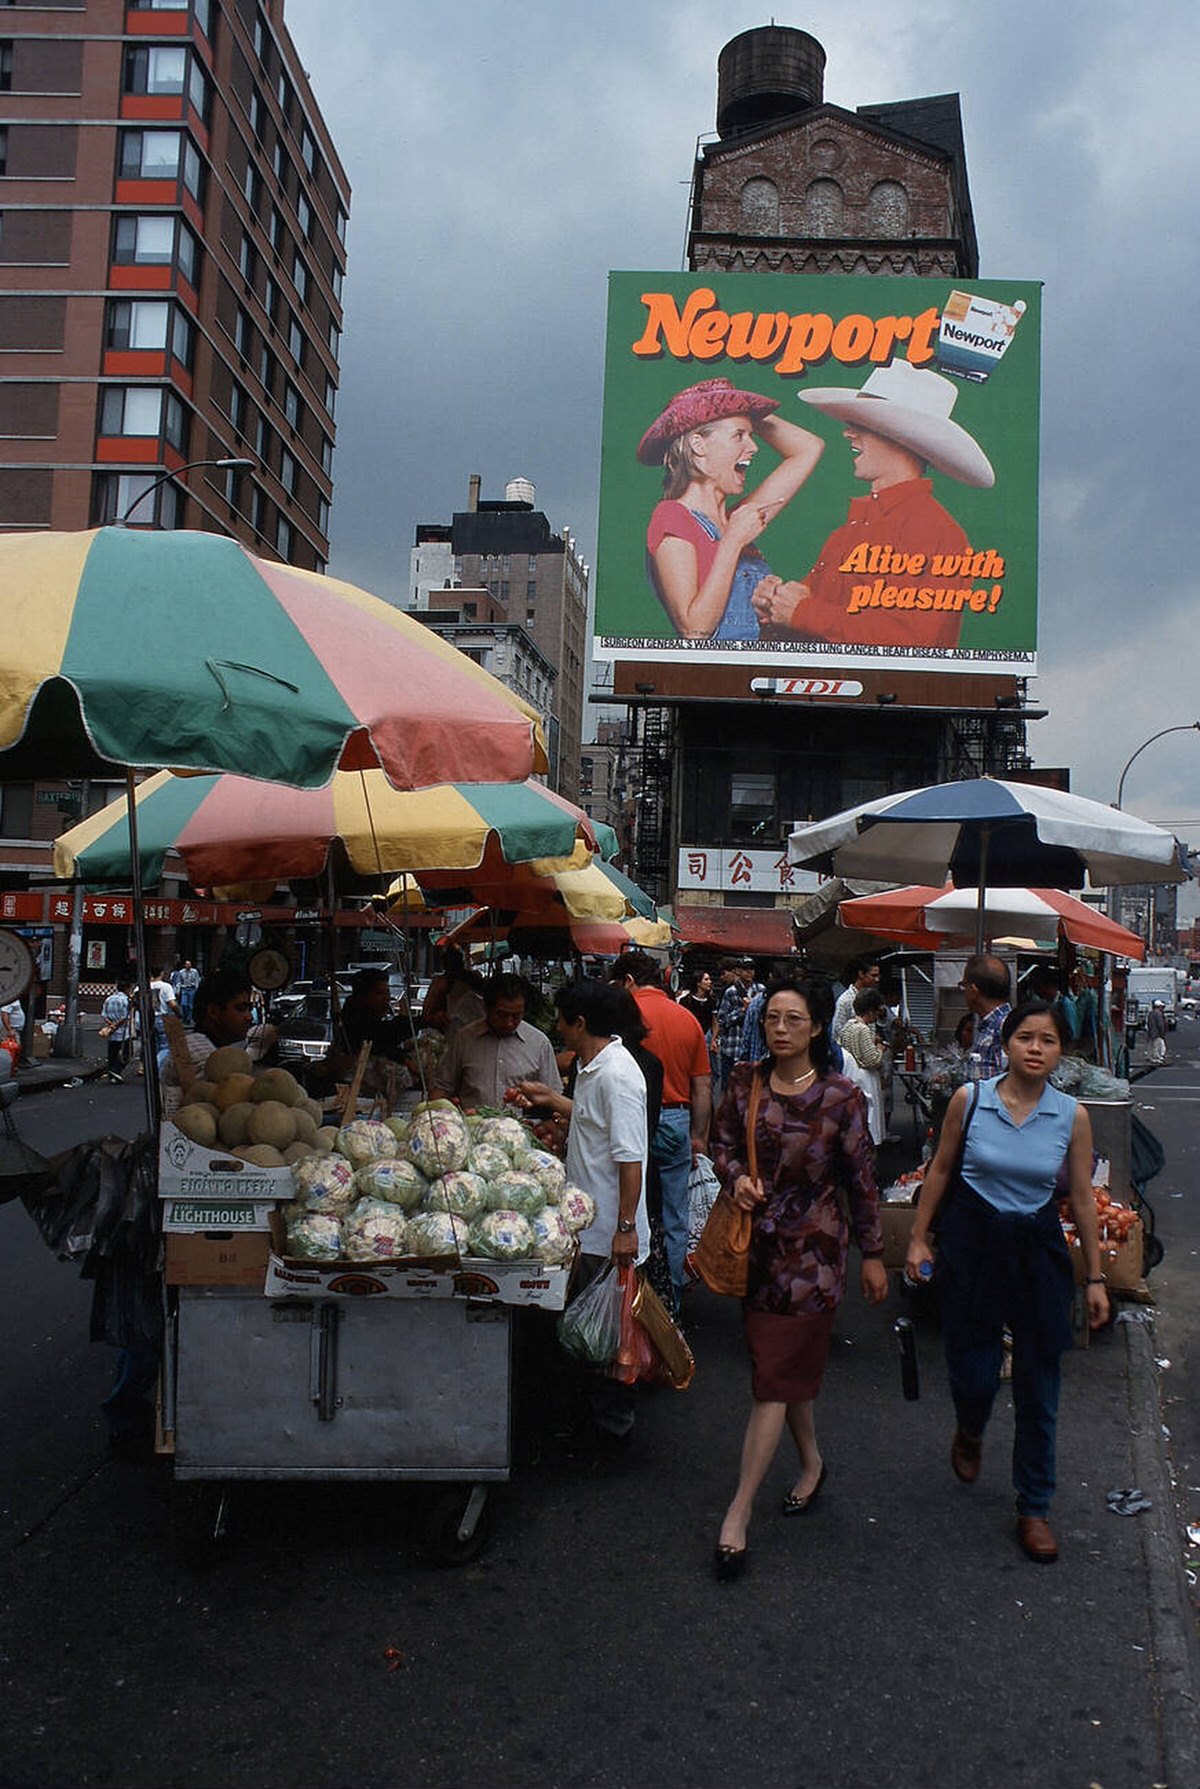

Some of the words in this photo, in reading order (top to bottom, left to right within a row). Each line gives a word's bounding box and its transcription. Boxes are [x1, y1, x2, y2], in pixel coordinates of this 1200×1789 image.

[633, 289, 938, 373] Newport
[943, 323, 1006, 352] Newport
[839, 543, 926, 574] Alive
[932, 547, 1004, 577] with
[847, 578, 1001, 613] pleasure!
[604, 637, 644, 648] SURGEON
[741, 640, 782, 652] SMOKING
[784, 642, 816, 653] CAUSES
[819, 643, 842, 654] LUNG
[882, 645, 911, 657] HEART
[951, 649, 970, 659] AND
[783, 679, 843, 694] TDI
[173, 1210, 254, 1224] LIGHTHOUSE
